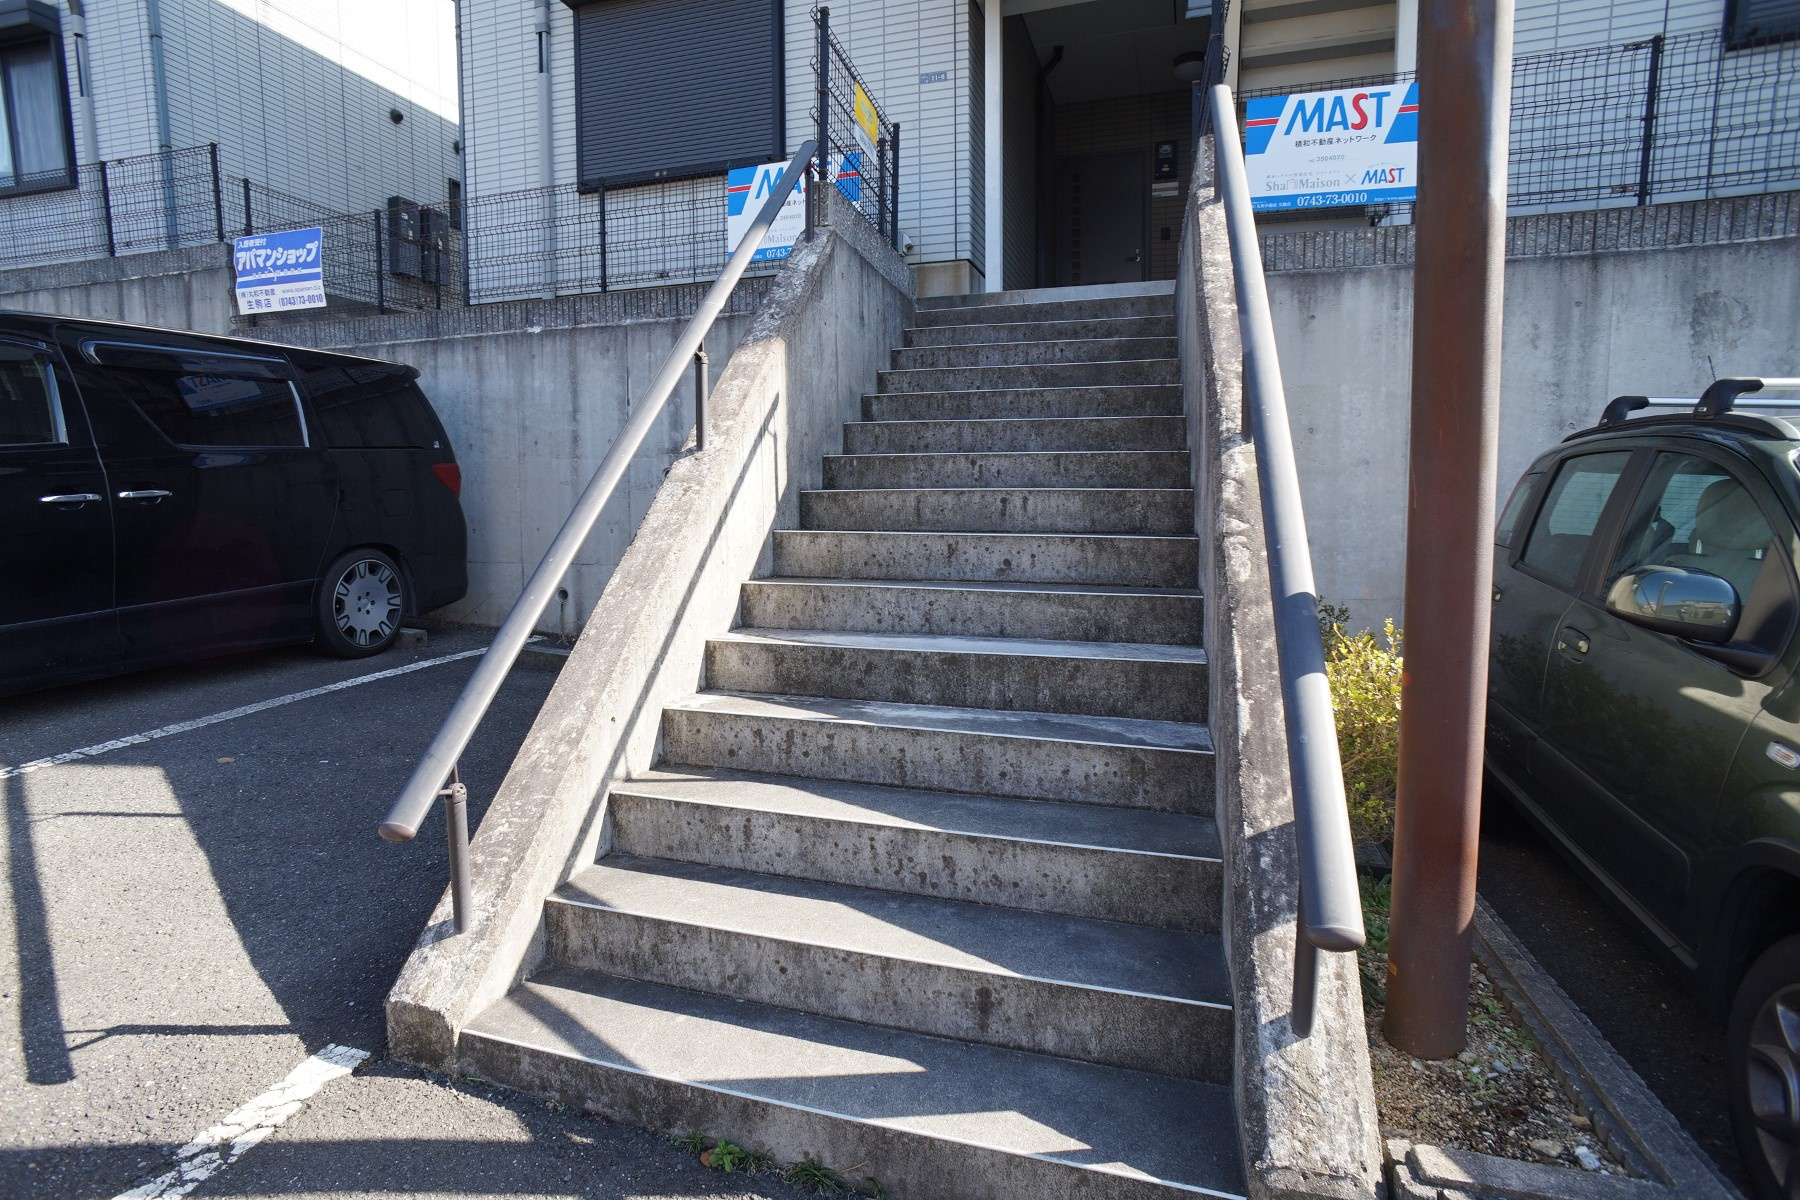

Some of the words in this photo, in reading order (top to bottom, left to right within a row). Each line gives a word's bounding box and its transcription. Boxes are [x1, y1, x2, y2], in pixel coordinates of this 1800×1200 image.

[1284, 91, 1391, 136] MAST
[1294, 134, 1377, 148] 積和不動産ネットワーク
[1316, 154, 1345, 162] 3504020
[1361, 167, 1405, 186] MAST
[1296, 192, 1368, 207] 0743-73-0010
[236, 240, 319, 271] アパマンショップ
[279, 294, 324, 307] (0743)73-0010
